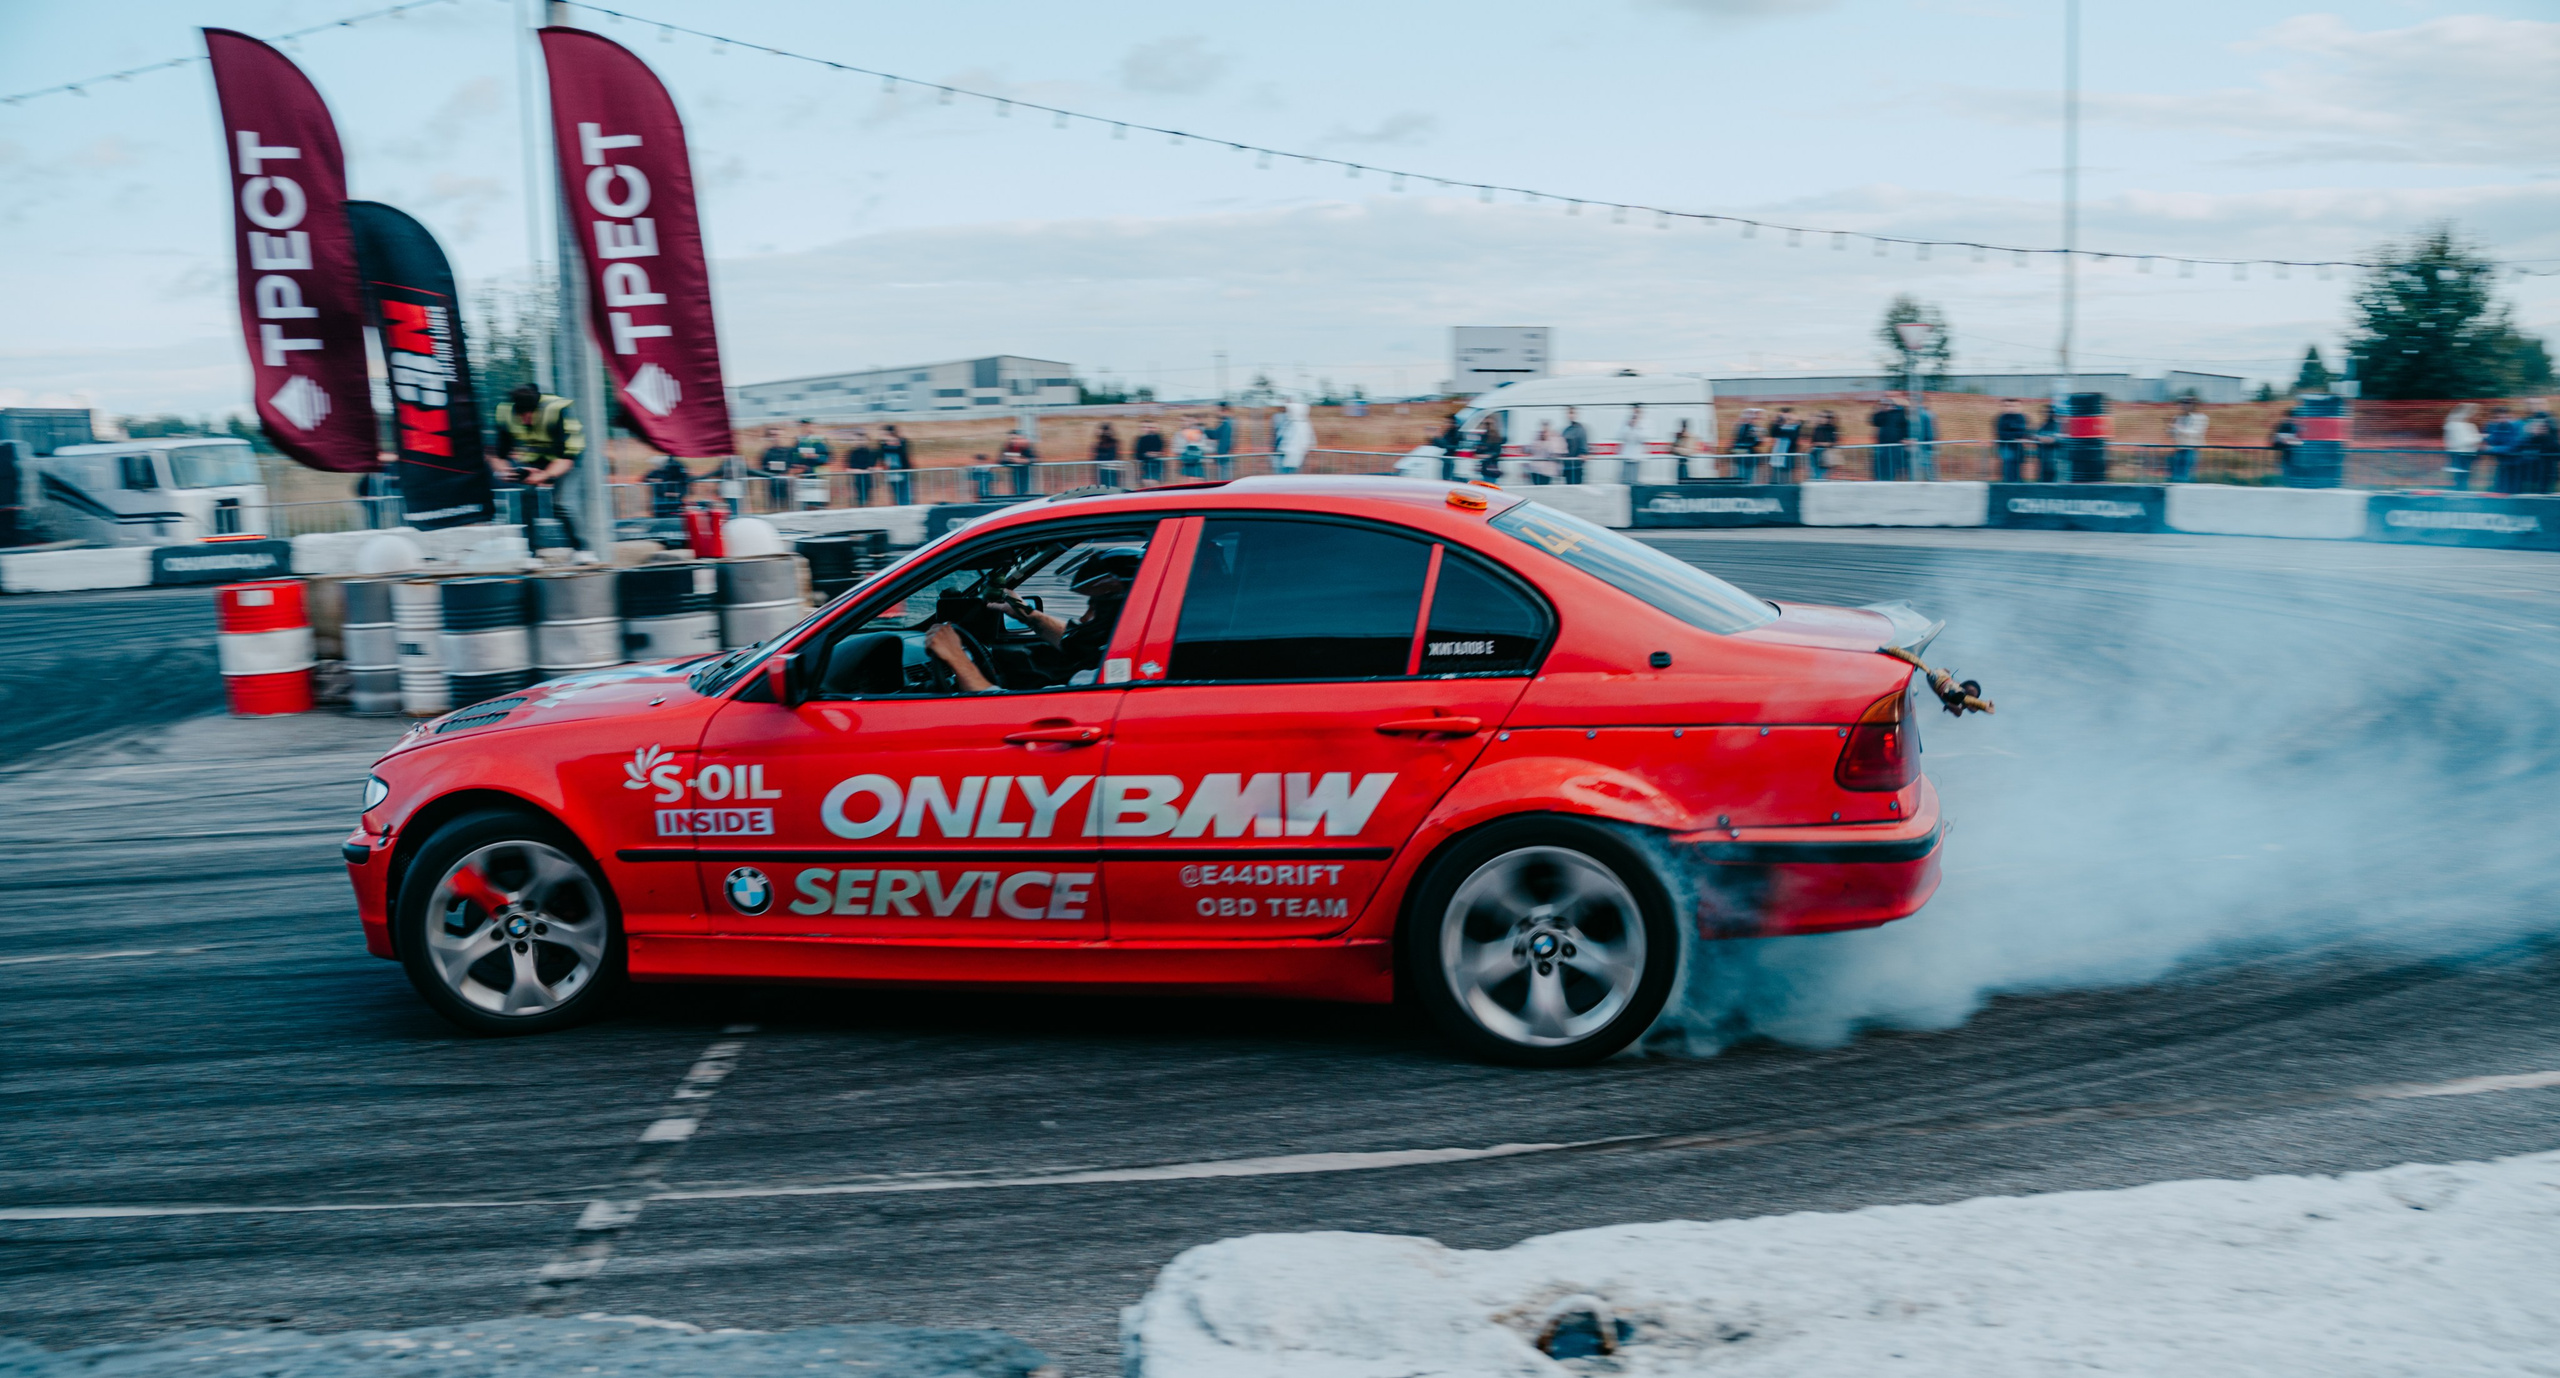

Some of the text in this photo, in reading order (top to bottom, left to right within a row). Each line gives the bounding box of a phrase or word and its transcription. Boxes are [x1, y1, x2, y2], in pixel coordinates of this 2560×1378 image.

[650, 764, 782, 803] S-OIL
[662, 810, 767, 834] INSIDE
[1179, 864, 1345, 888] @E44DRIFT
[788, 868, 1097, 921] SERVICE
[1196, 897, 1349, 918] OBD TEAM
